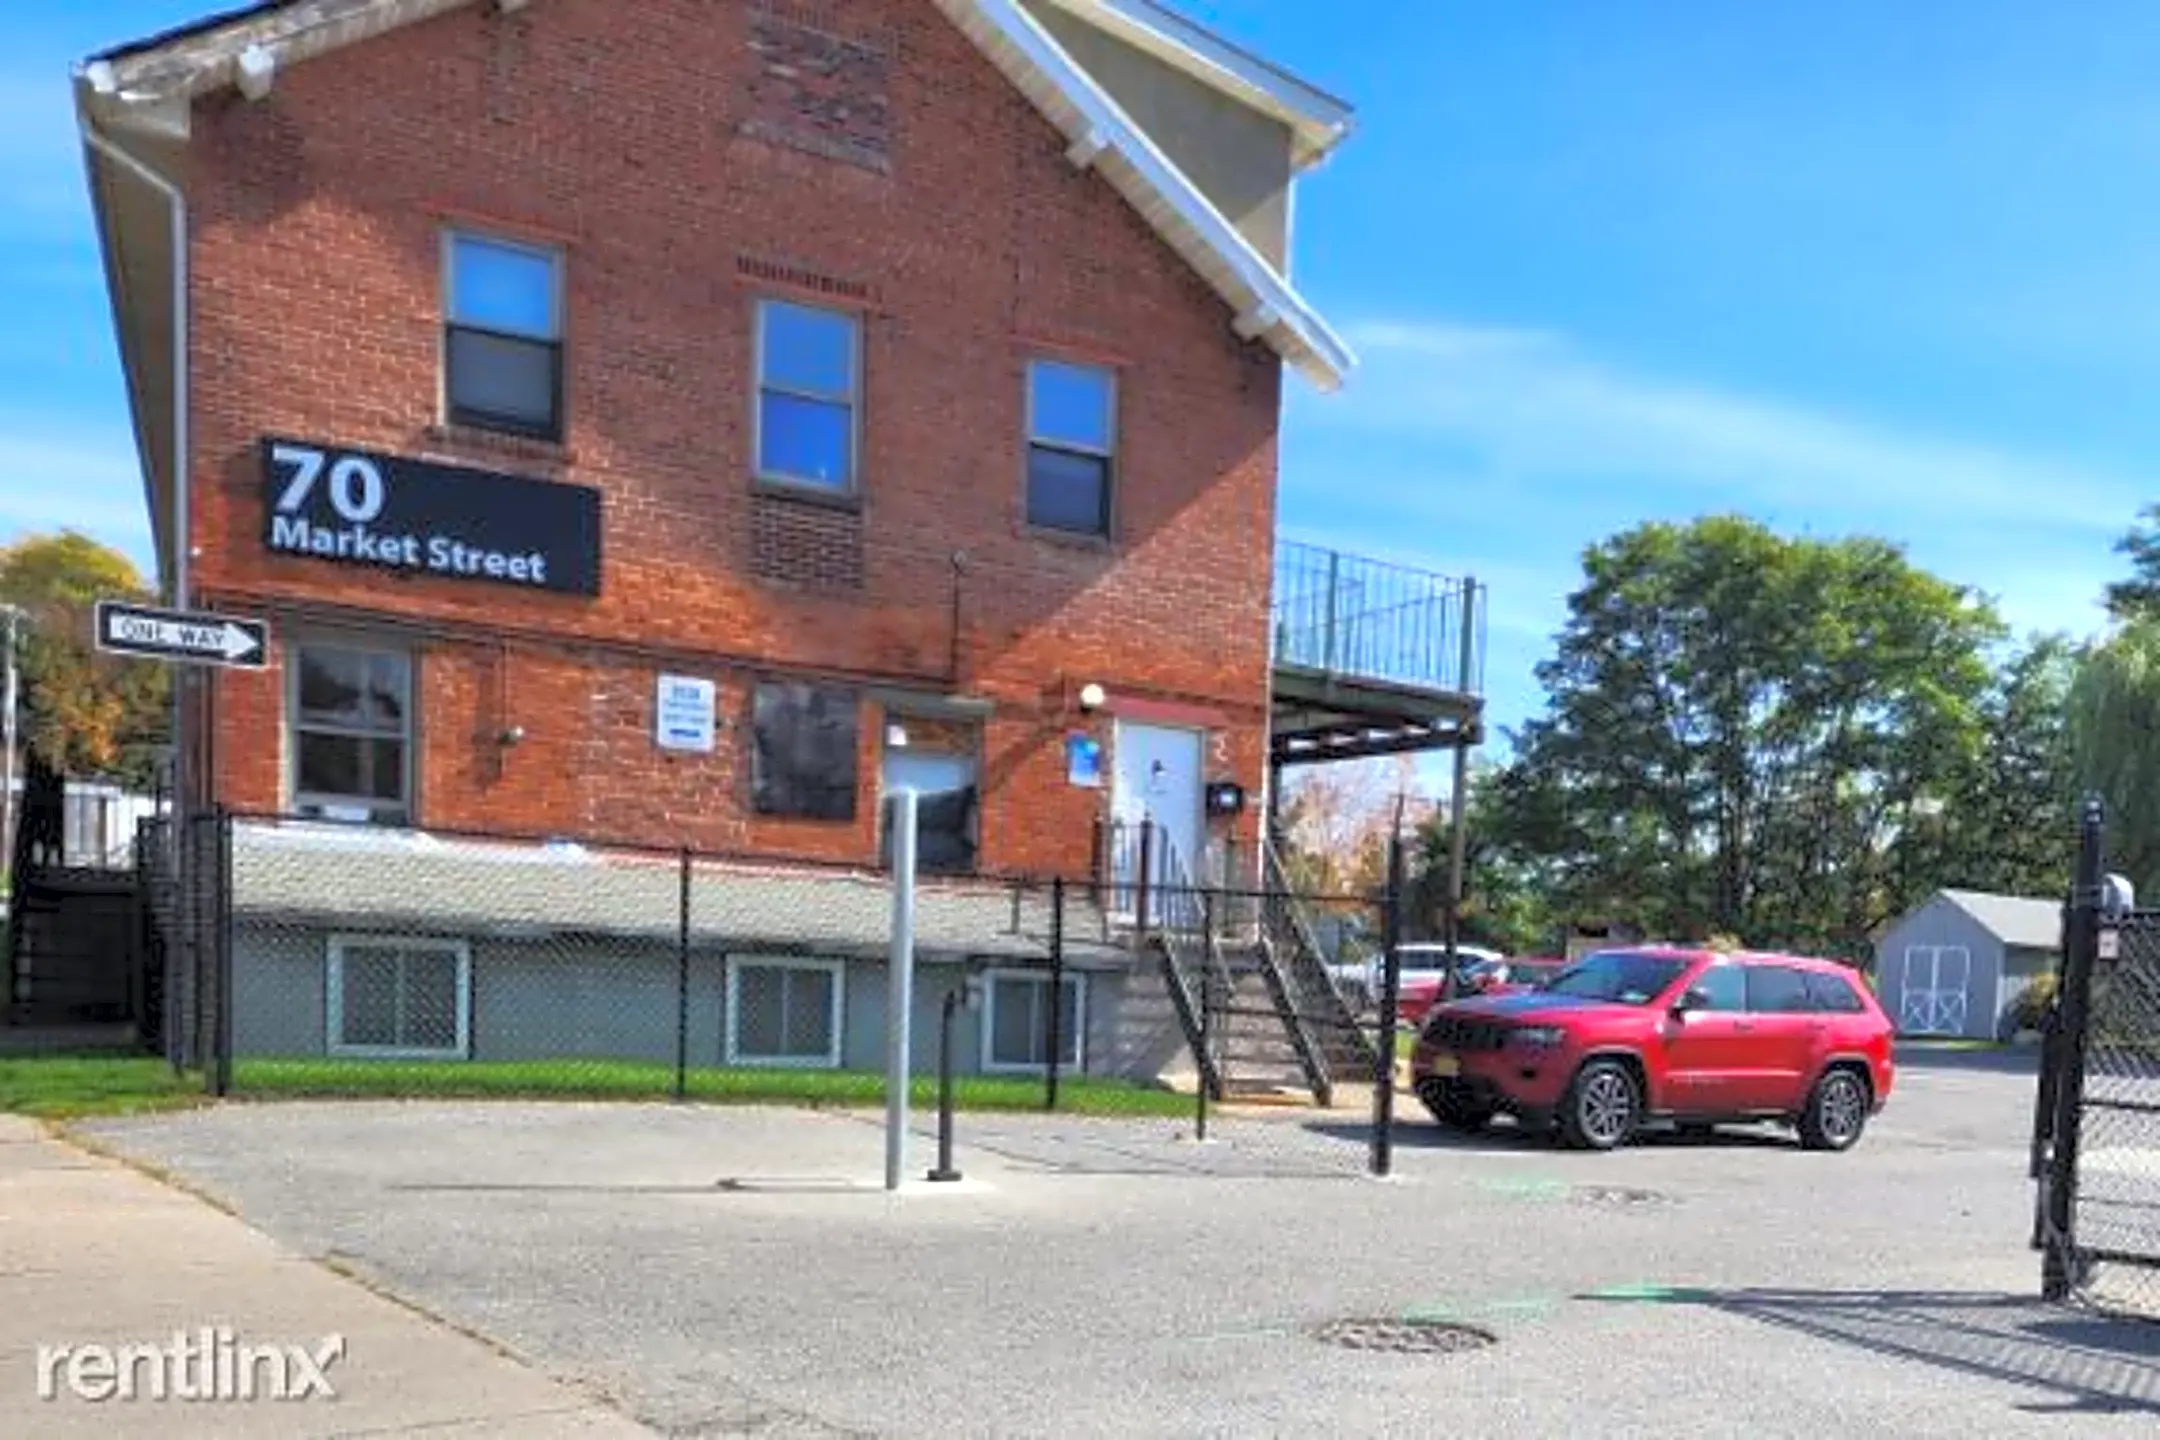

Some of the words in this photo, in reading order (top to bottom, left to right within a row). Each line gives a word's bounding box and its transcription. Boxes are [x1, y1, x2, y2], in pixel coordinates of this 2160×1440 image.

[272, 445, 385, 523] 70
[271, 516, 420, 565] Market
[427, 537, 548, 583] Street
[121, 617, 167, 643] ONE
[178, 627, 225, 645] WAY
